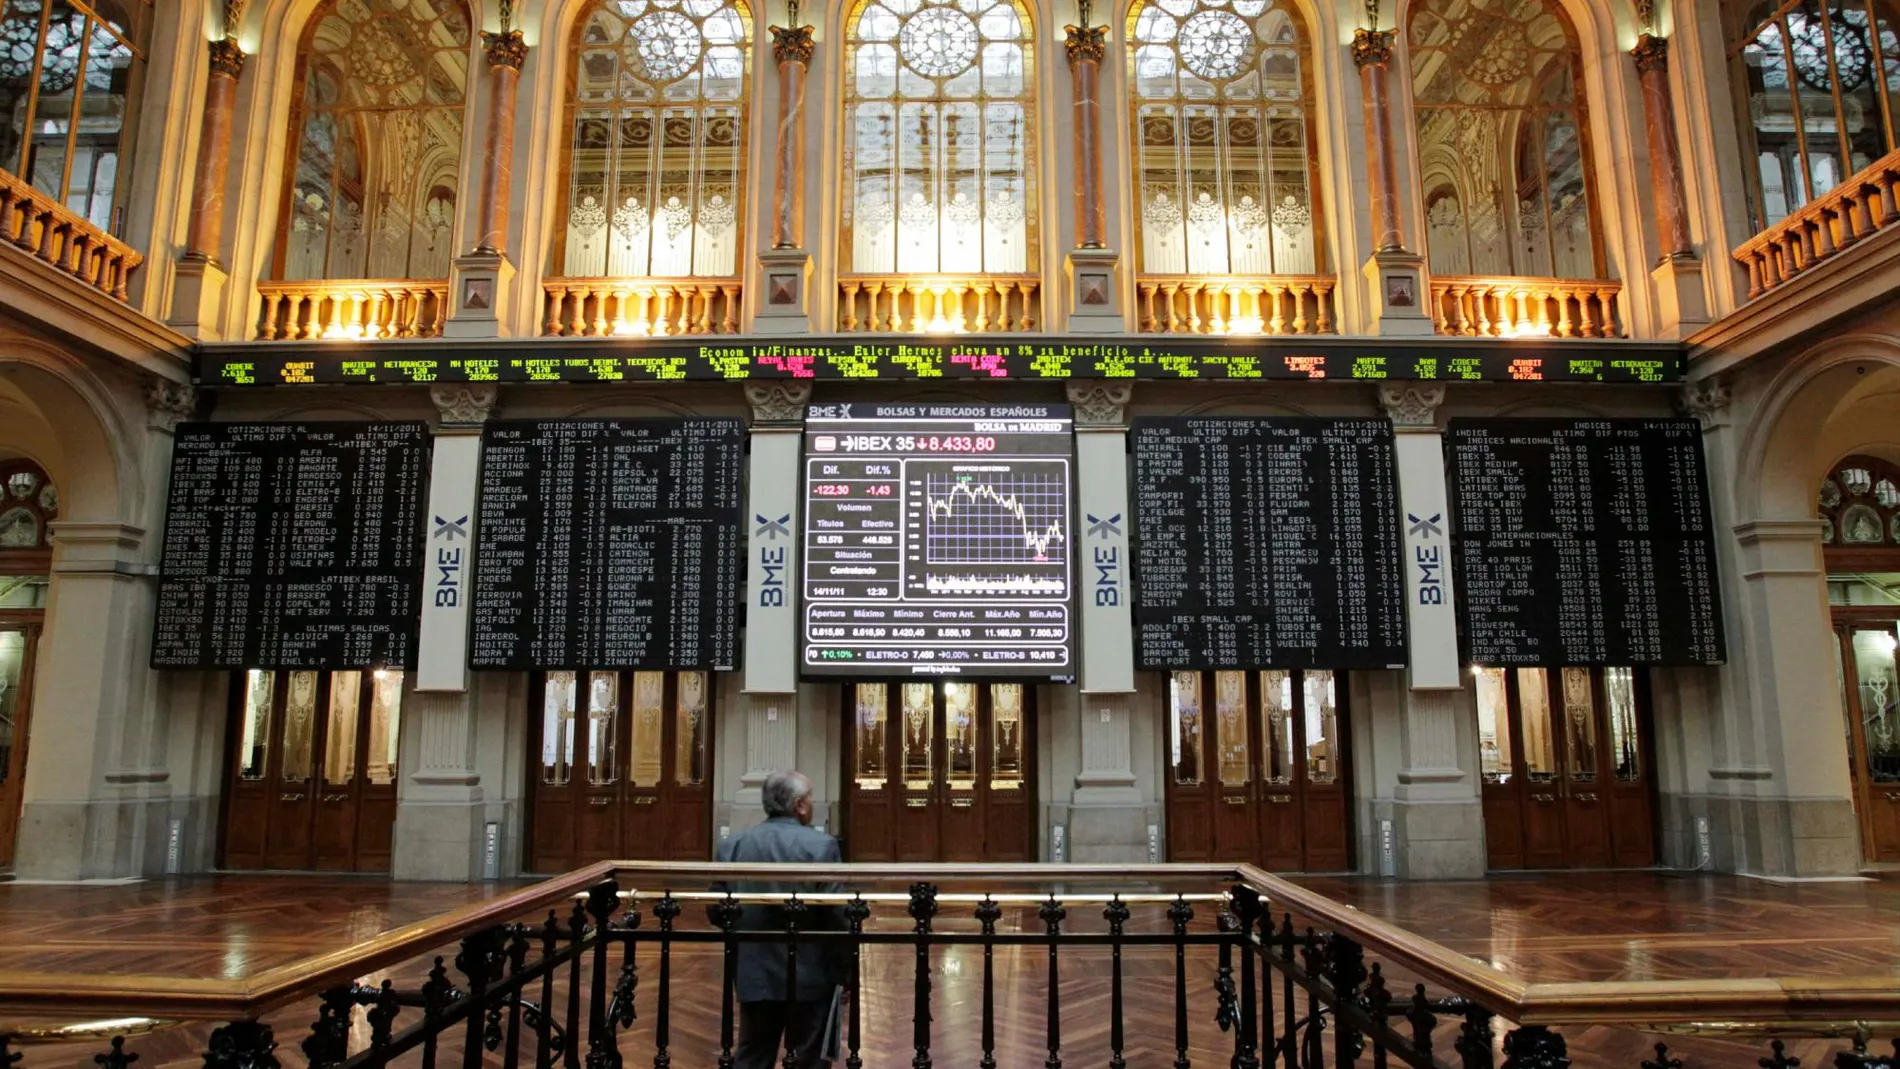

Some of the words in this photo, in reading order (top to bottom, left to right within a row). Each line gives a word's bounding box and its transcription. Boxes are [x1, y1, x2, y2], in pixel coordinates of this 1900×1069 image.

[952, 346, 987, 356] eleva
[1018, 346, 1033, 355] 8%
[1063, 346, 1128, 355] beneficio
[809, 406, 836, 417] BME
[877, 407, 915, 416] BOLSAS
[919, 407, 925, 416] Y
[930, 407, 985, 416] MERCADOS
[990, 406, 1047, 416] ESPAÑOLES
[974, 423, 1006, 432] BOLSA
[1020, 423, 1062, 432] MADRID
[854, 436, 891, 451] IBEX
[896, 436, 915, 451] 35
[930, 436, 995, 453] 8.433,80
[823, 466, 839, 474] Dif.
[866, 466, 891, 474] Dif.%
[813, 486, 848, 495] -122,30
[866, 486, 890, 495] -1,43
[835, 551, 872, 559] Situación
[436, 548, 460, 607] BME
[760, 546, 784, 607] BME
[1095, 546, 1118, 607] BME
[1417, 545, 1441, 605] BME
[811, 610, 845, 619] Apertura
[854, 609, 885, 617] Máximo
[894, 609, 924, 617] Mínimo
[893, 628, 925, 637] 8.420,40
[1030, 652, 1055, 660] 10,410
